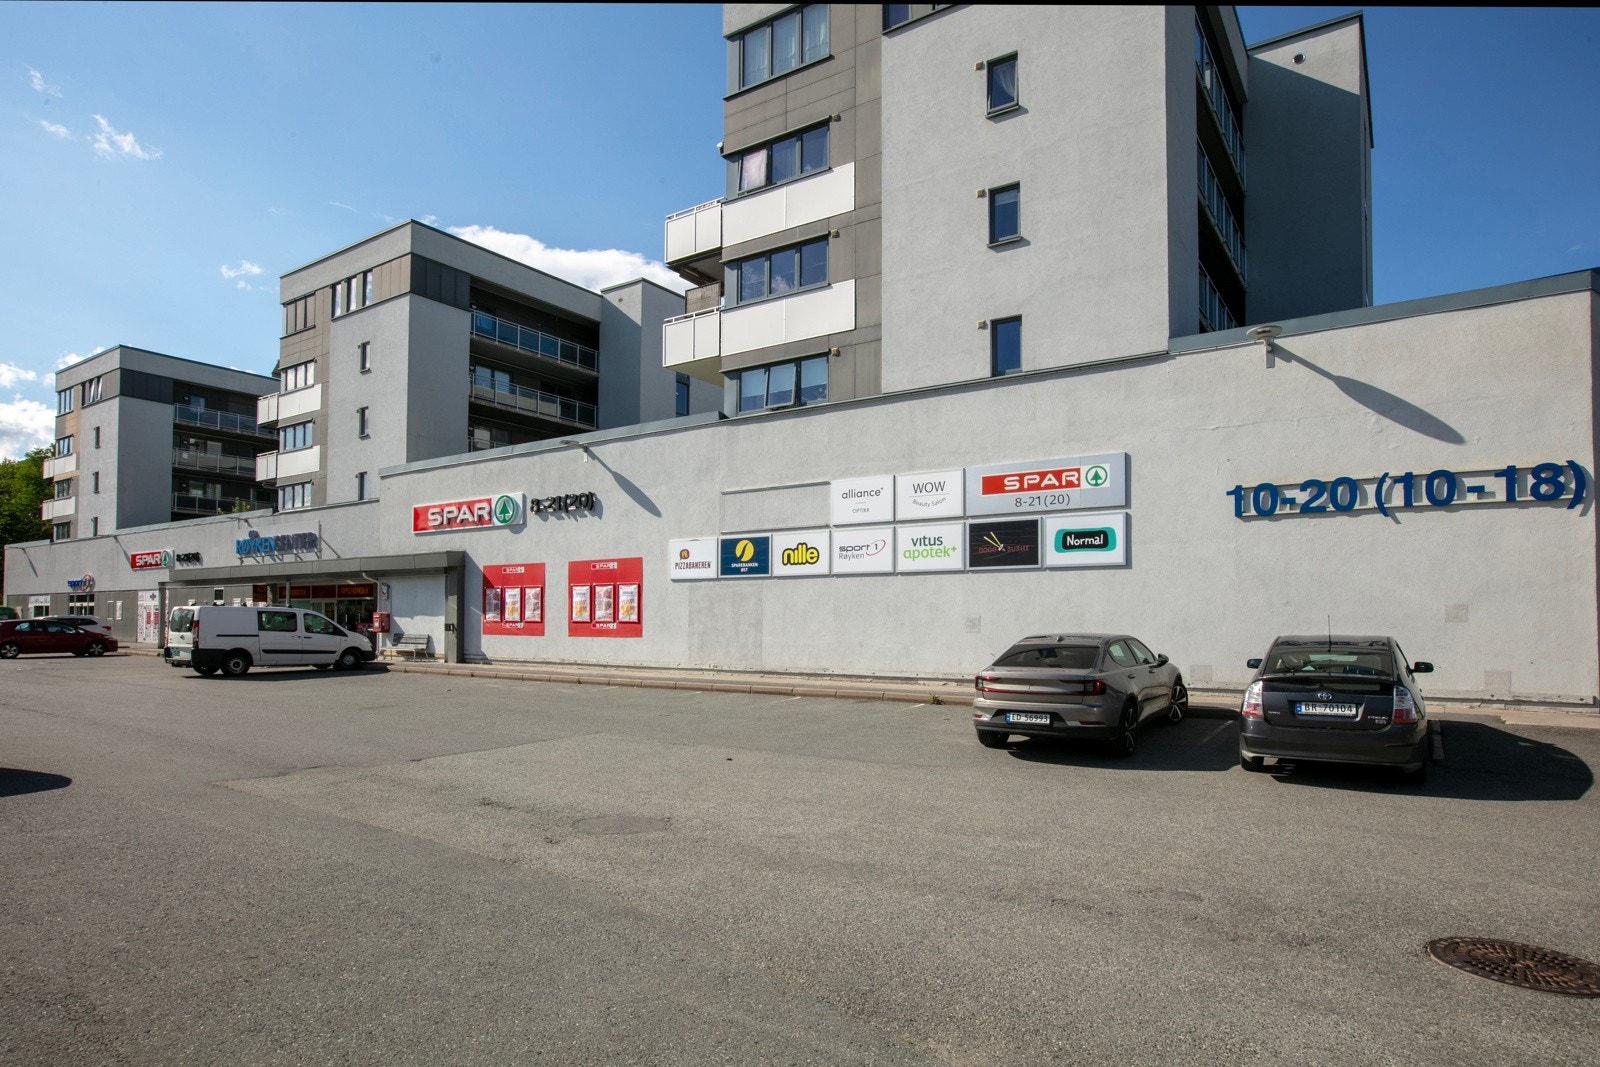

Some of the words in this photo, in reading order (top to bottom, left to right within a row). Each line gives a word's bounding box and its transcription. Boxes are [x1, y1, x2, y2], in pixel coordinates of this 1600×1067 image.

[912, 480, 946, 494] WOW
[1004, 471, 1079, 491] SPAR
[912, 498, 931, 508] Beauty
[931, 497, 947, 506] Salon
[1015, 493, 1071, 508] 8-21(20)
[1226, 477, 1358, 518] 10-20
[428, 502, 491, 527] SPAR
[911, 535, 943, 547] vitus
[1066, 533, 1104, 546] Normal
[782, 542, 820, 567] nille
[838, 543, 871, 553] sport
[135, 554, 161, 567] SPAR
[838, 552, 865, 562] Røyken
[1304, 703, 1317, 711] BR
[1323, 703, 1353, 713] 70104
[1024, 715, 1048, 723] 56993
